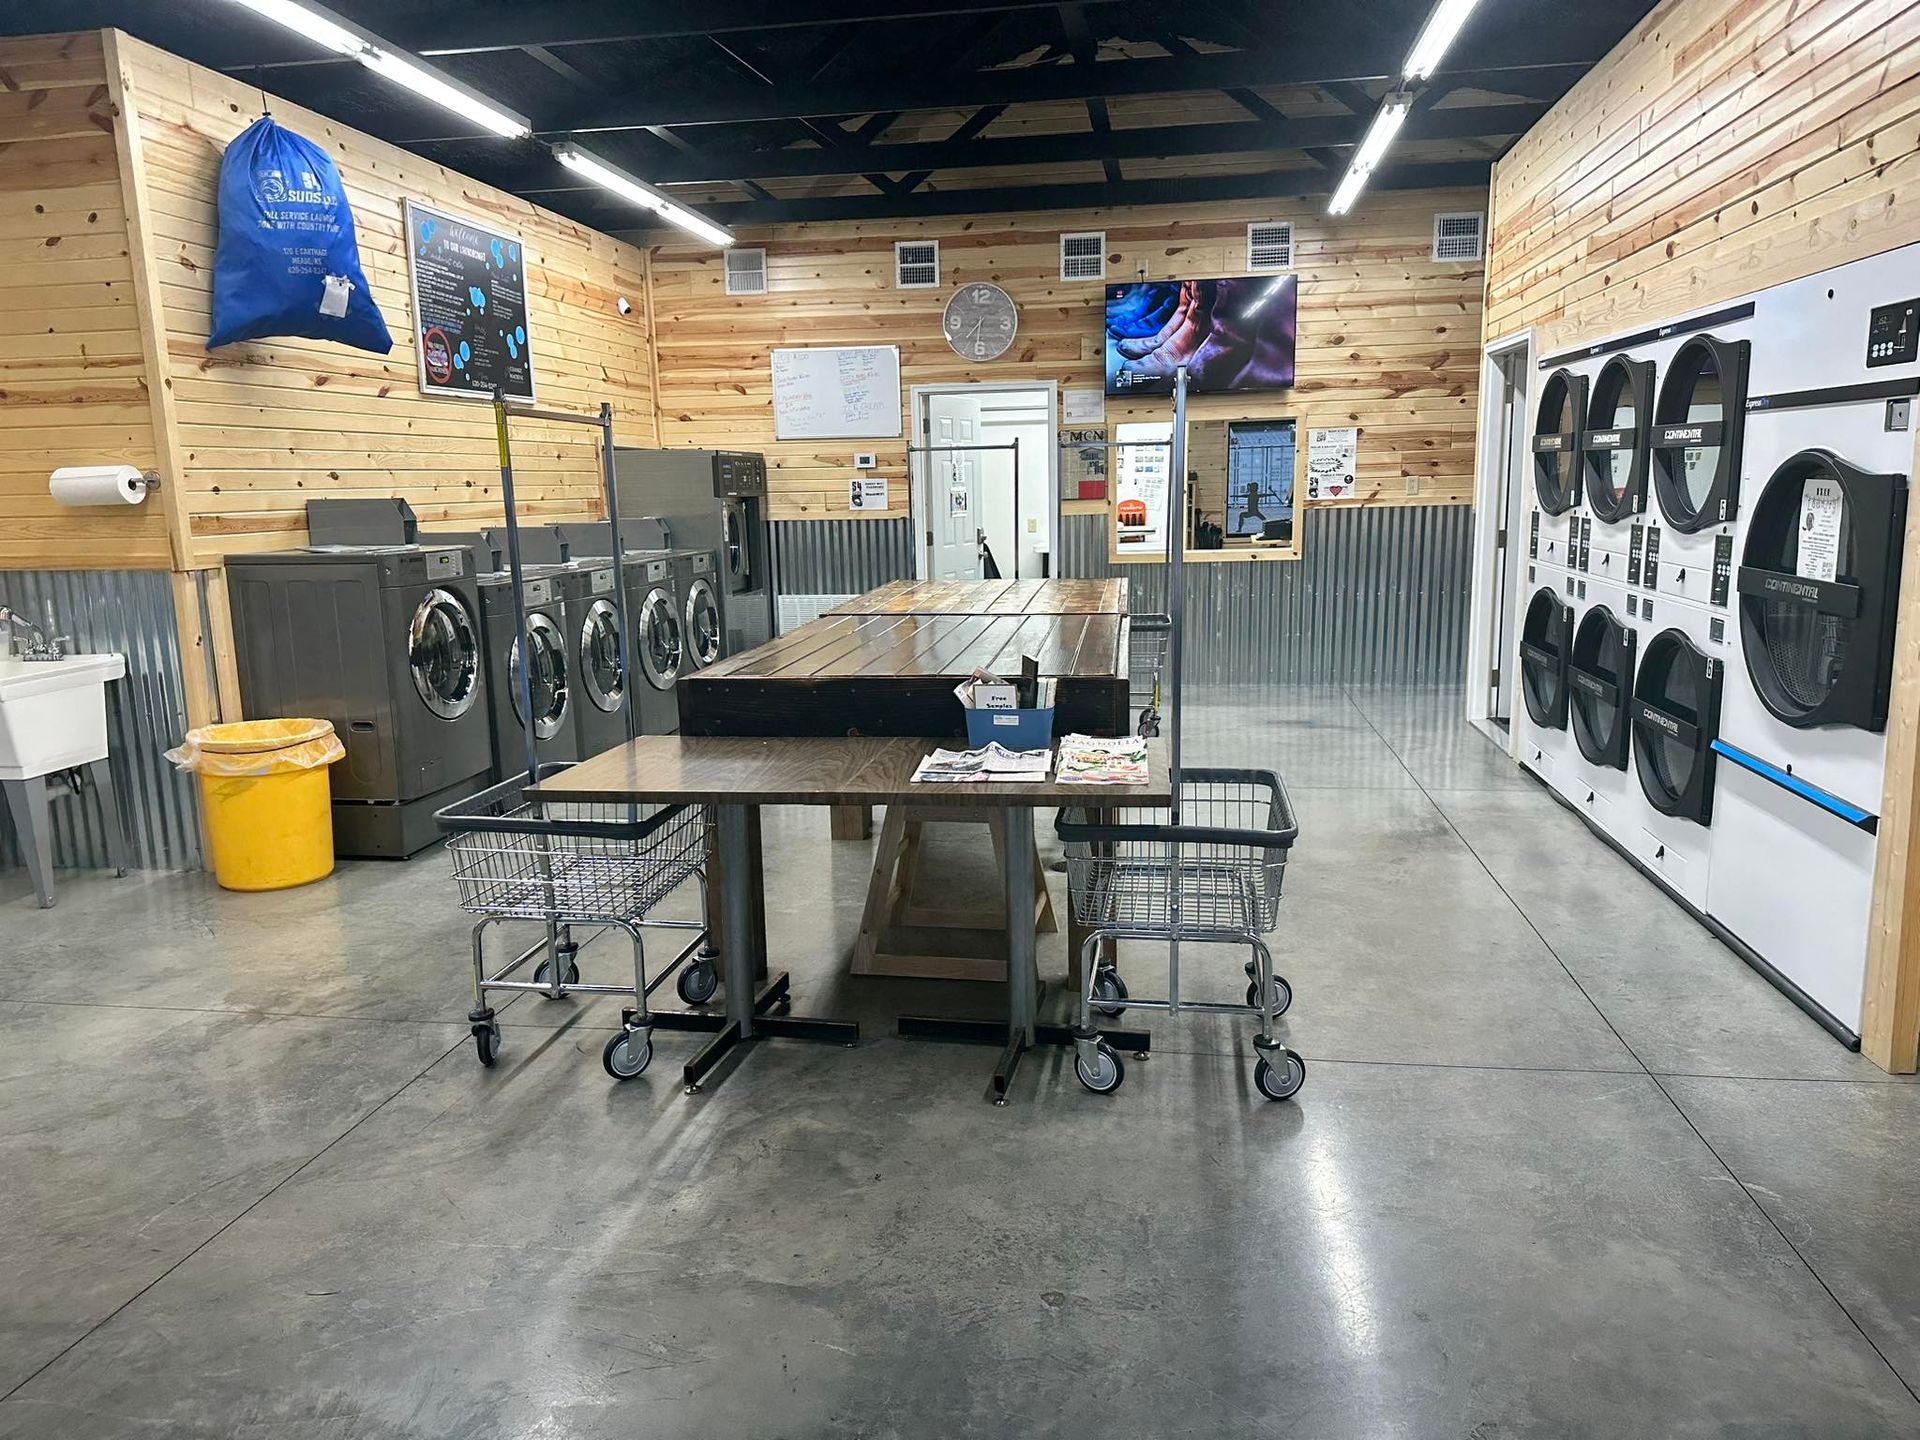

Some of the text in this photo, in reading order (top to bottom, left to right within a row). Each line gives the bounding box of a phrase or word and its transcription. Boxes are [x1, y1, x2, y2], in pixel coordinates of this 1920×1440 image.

[288, 189, 321, 204] SUDS
[280, 211, 309, 221] SERVICE
[276, 220, 295, 230] WITH
[971, 288, 992, 305] 12
[950, 315, 1013, 331] 9 3
[974, 341, 986, 356] 6
[1664, 428, 1703, 440] CONTINENTAL
[1764, 578, 1819, 599] CONTINENTAL
[1643, 708, 1679, 734] CONTINENTAL
[1064, 737, 1140, 747] MAGNOLIA
